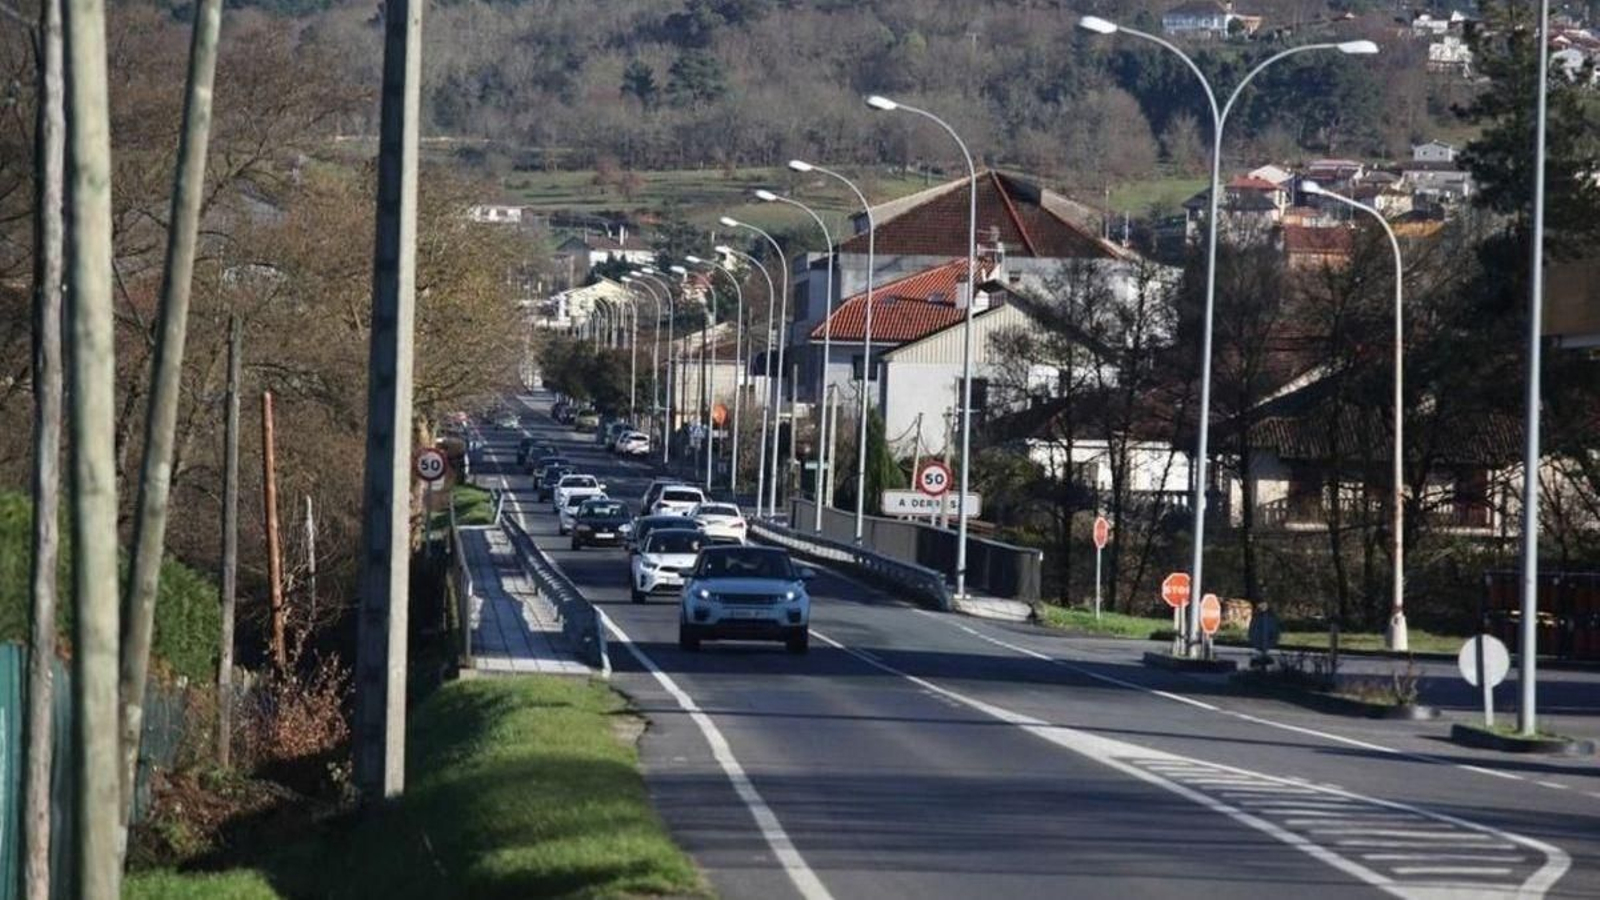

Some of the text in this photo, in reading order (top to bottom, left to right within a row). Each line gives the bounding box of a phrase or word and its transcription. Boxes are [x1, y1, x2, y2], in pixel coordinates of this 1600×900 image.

[421, 459, 440, 471] 50
[924, 473, 945, 485] 50
[898, 498, 962, 509] A DERS
